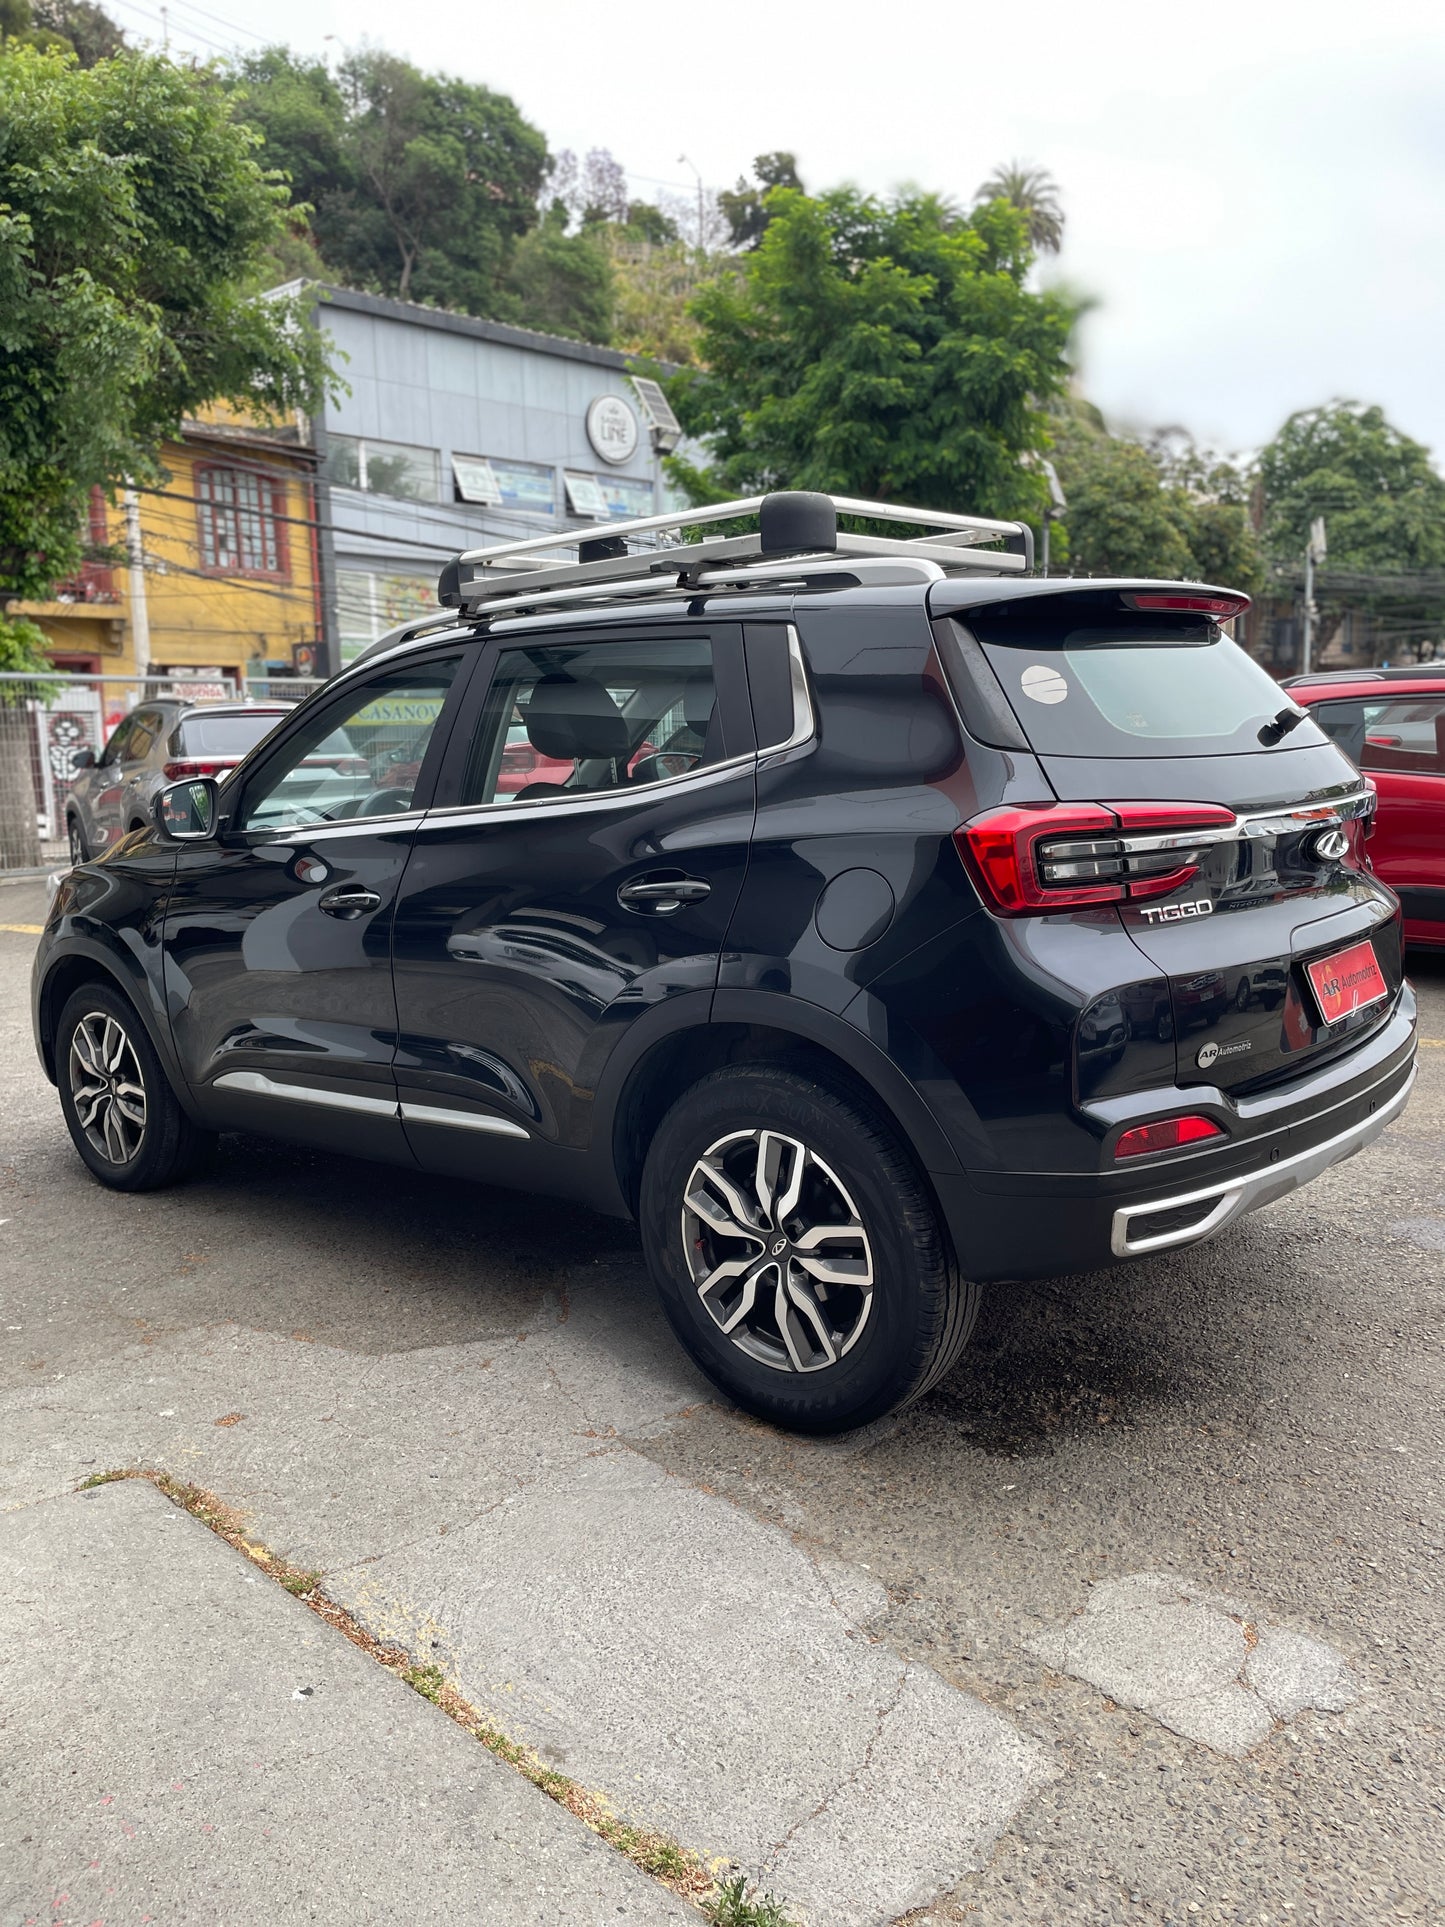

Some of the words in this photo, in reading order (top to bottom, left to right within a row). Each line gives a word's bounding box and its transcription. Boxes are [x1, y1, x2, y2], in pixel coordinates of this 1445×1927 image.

[1140, 899, 1213, 924] TIGGO
[1322, 978, 1341, 999] AR
[1341, 963, 1377, 990] Automotriz
[1200, 1049, 1217, 1060] AR
[1218, 1042, 1252, 1056] Automotriz
